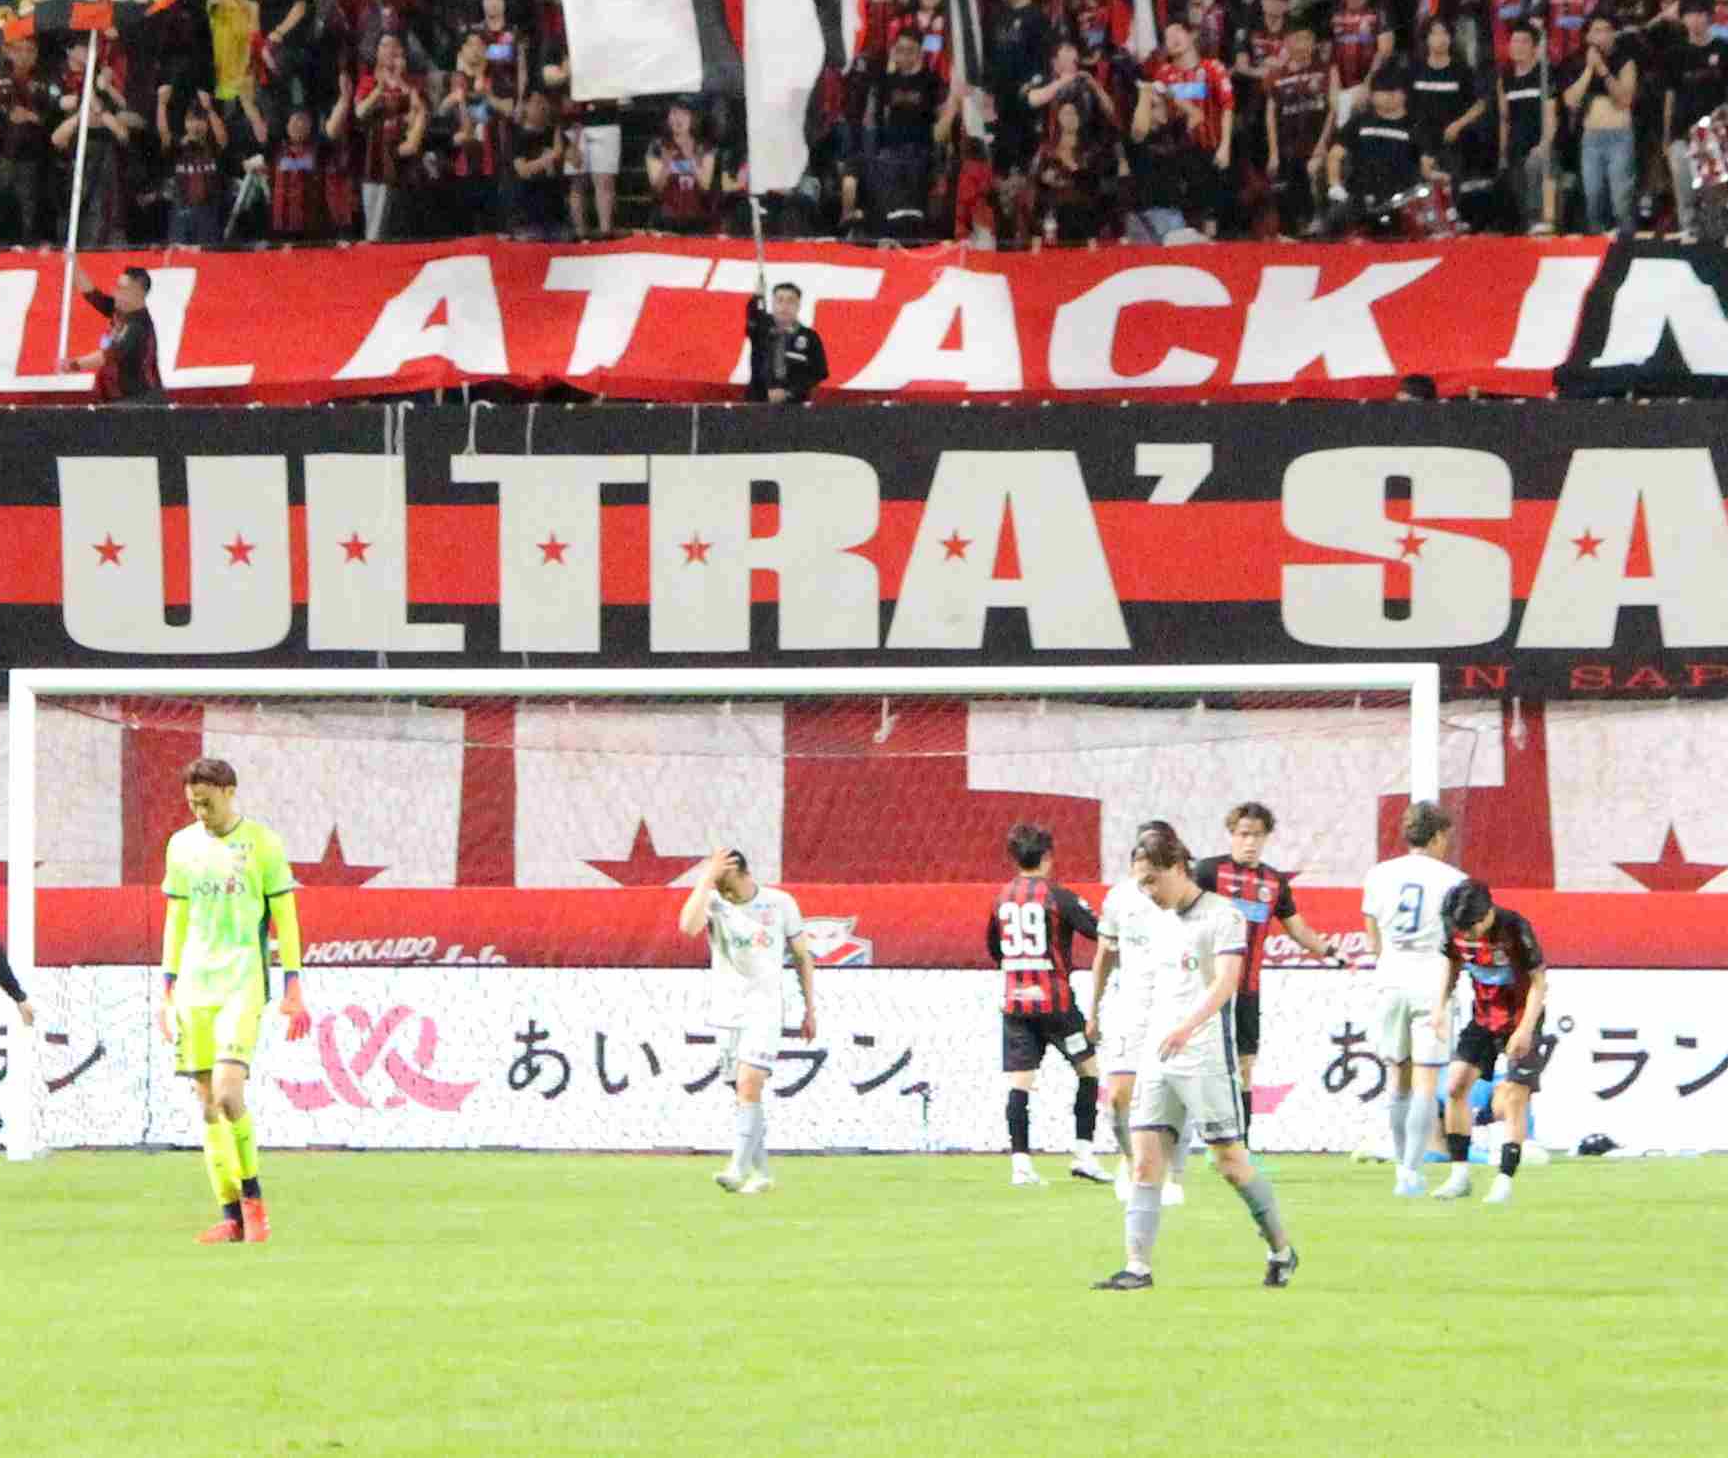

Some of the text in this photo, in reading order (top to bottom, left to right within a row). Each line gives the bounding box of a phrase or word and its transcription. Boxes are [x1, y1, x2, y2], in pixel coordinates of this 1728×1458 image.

[333, 252, 1444, 392] ATTACK
[998, 901, 1047, 958] 39
[1395, 882, 1425, 934] 9
[303, 936, 438, 963] HOKKAIDO
